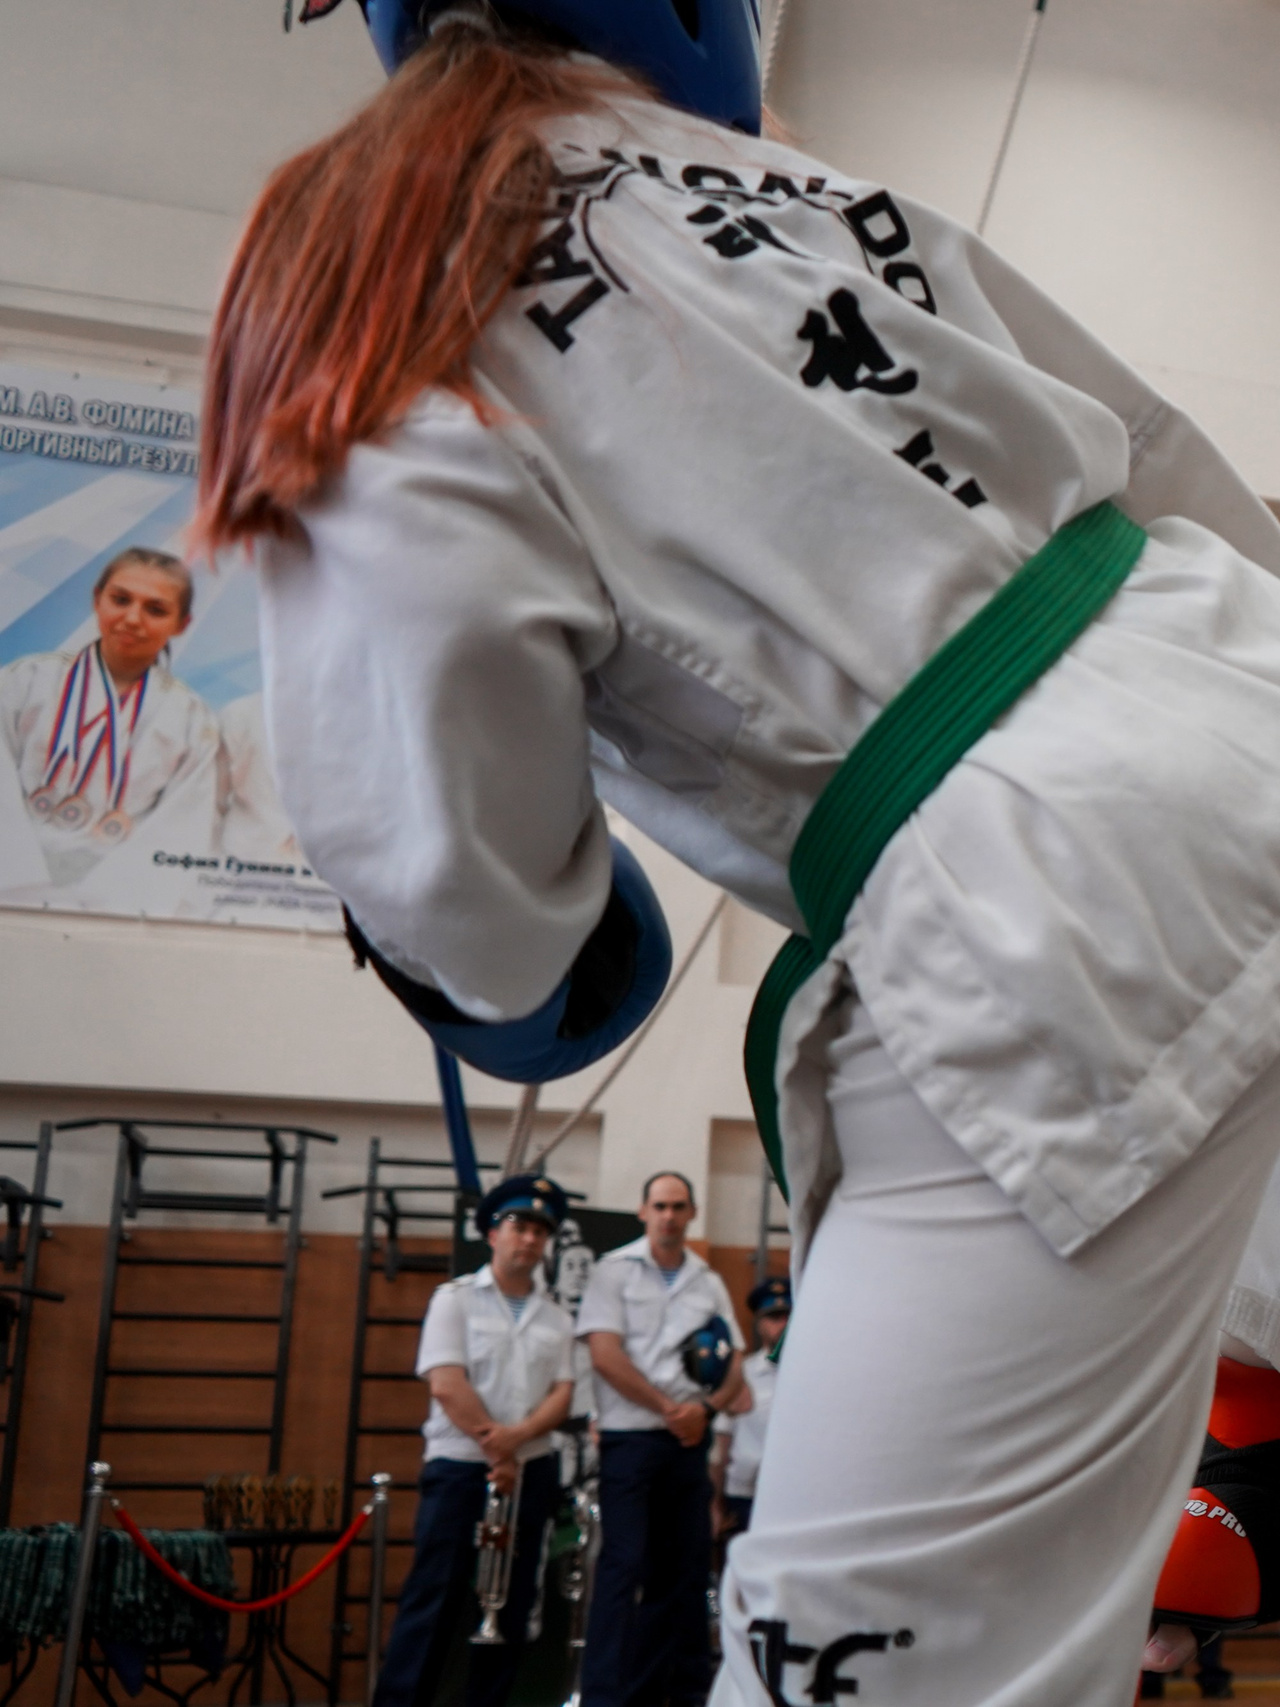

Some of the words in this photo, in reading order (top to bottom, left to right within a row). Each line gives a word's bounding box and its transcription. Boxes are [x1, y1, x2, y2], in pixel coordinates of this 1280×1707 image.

[82, 399, 194, 440] ФОМИНА
[0, 425, 124, 465] ОРТИВНЫЙ
[153, 850, 219, 870] София
